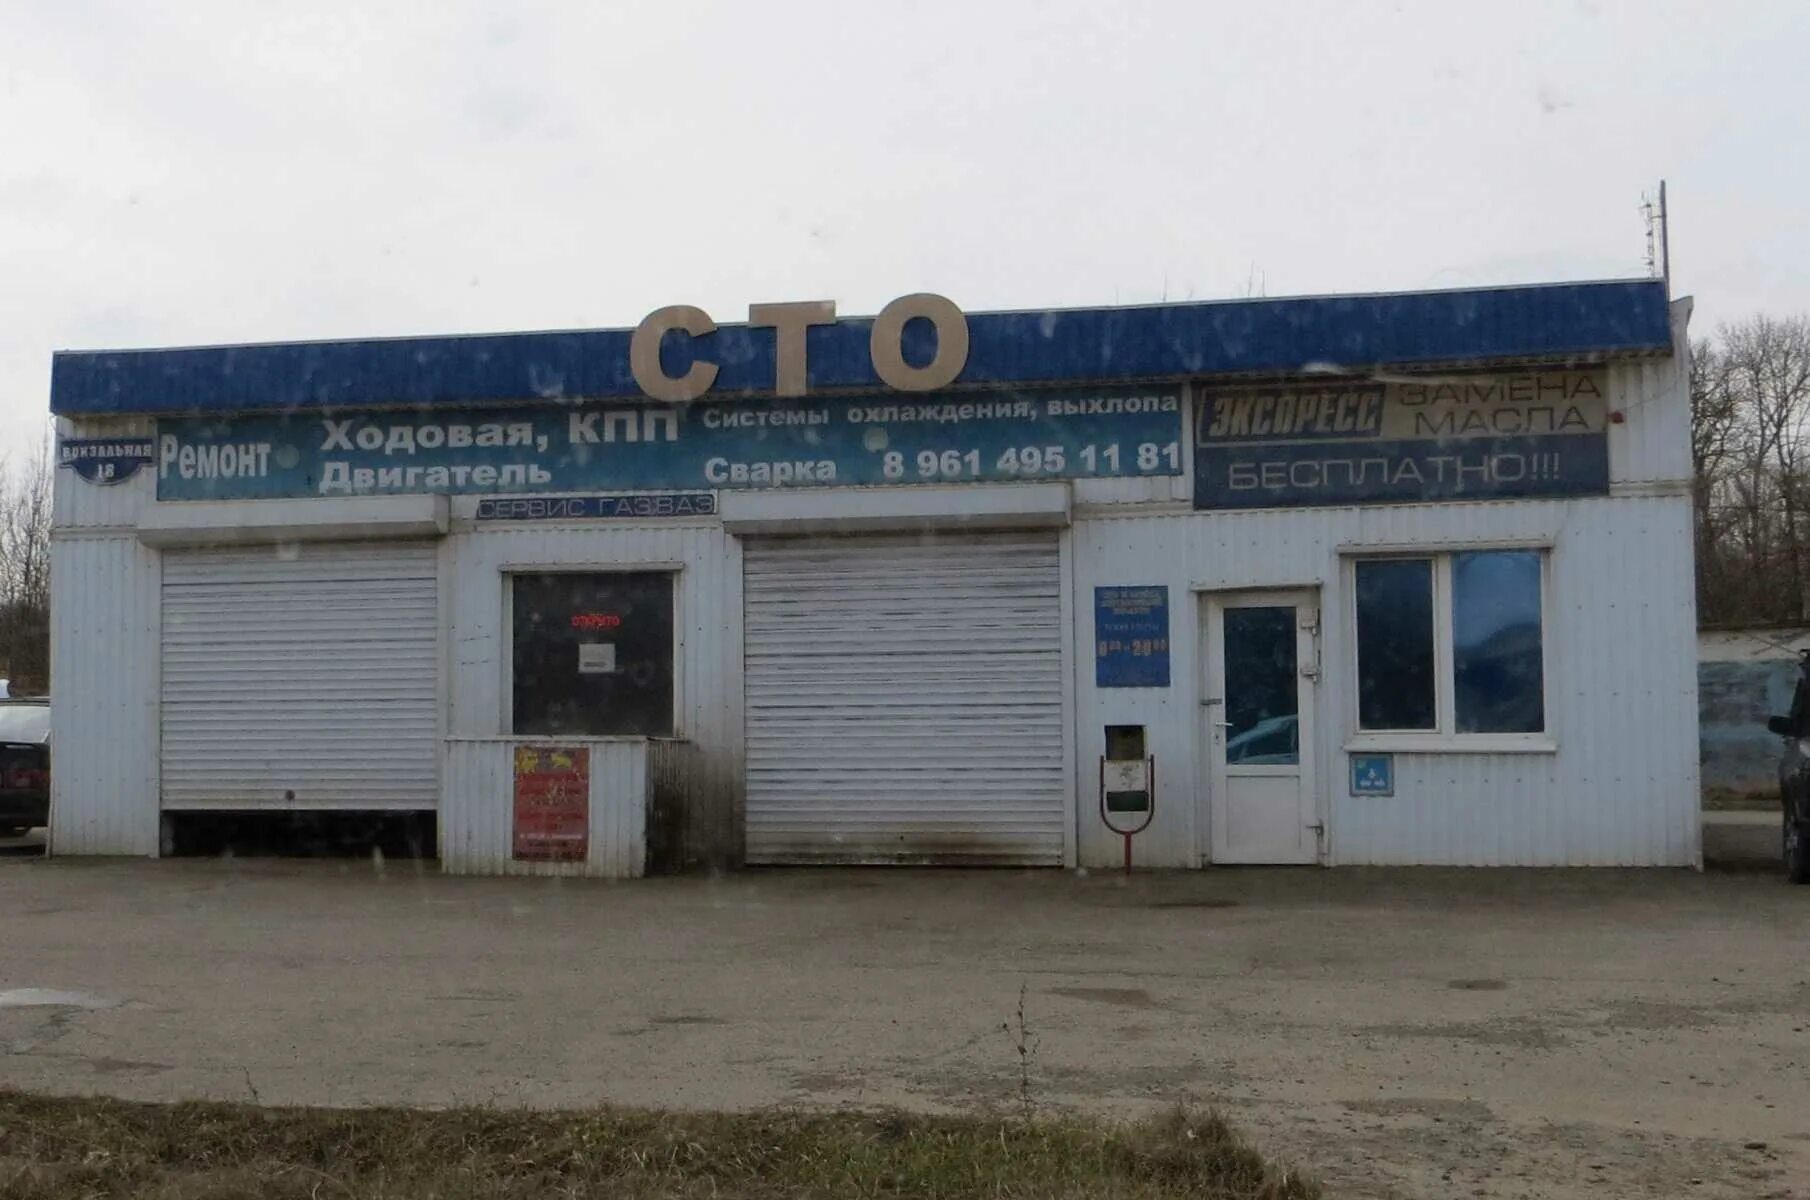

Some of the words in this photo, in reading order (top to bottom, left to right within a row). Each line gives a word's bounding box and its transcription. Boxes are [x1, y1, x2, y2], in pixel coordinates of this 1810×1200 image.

[630, 293, 969, 401] СТО
[1400, 376, 1601, 406] ЗАМЕНА
[703, 408, 829, 429] Системы
[847, 399, 1038, 424] охлаждения,
[1047, 393, 1179, 416] выхлопа
[1414, 406, 1590, 435] МАСЛА
[319, 419, 549, 456] Ходовая,
[568, 409, 679, 443] КПП
[97, 463, 115, 479] 18
[160, 433, 272, 480] Ремонт
[705, 457, 837, 487] Сварка
[883, 451, 904, 479] 8
[917, 449, 982, 477] 961
[996, 446, 1067, 475] 495
[1079, 443, 1120, 472] 11
[1137, 441, 1180, 470] 81
[1228, 452, 1561, 490] БЕСПЛАТНО!!!
[318, 461, 552, 494] Двигатель
[478, 499, 586, 519] СЕРВИС
